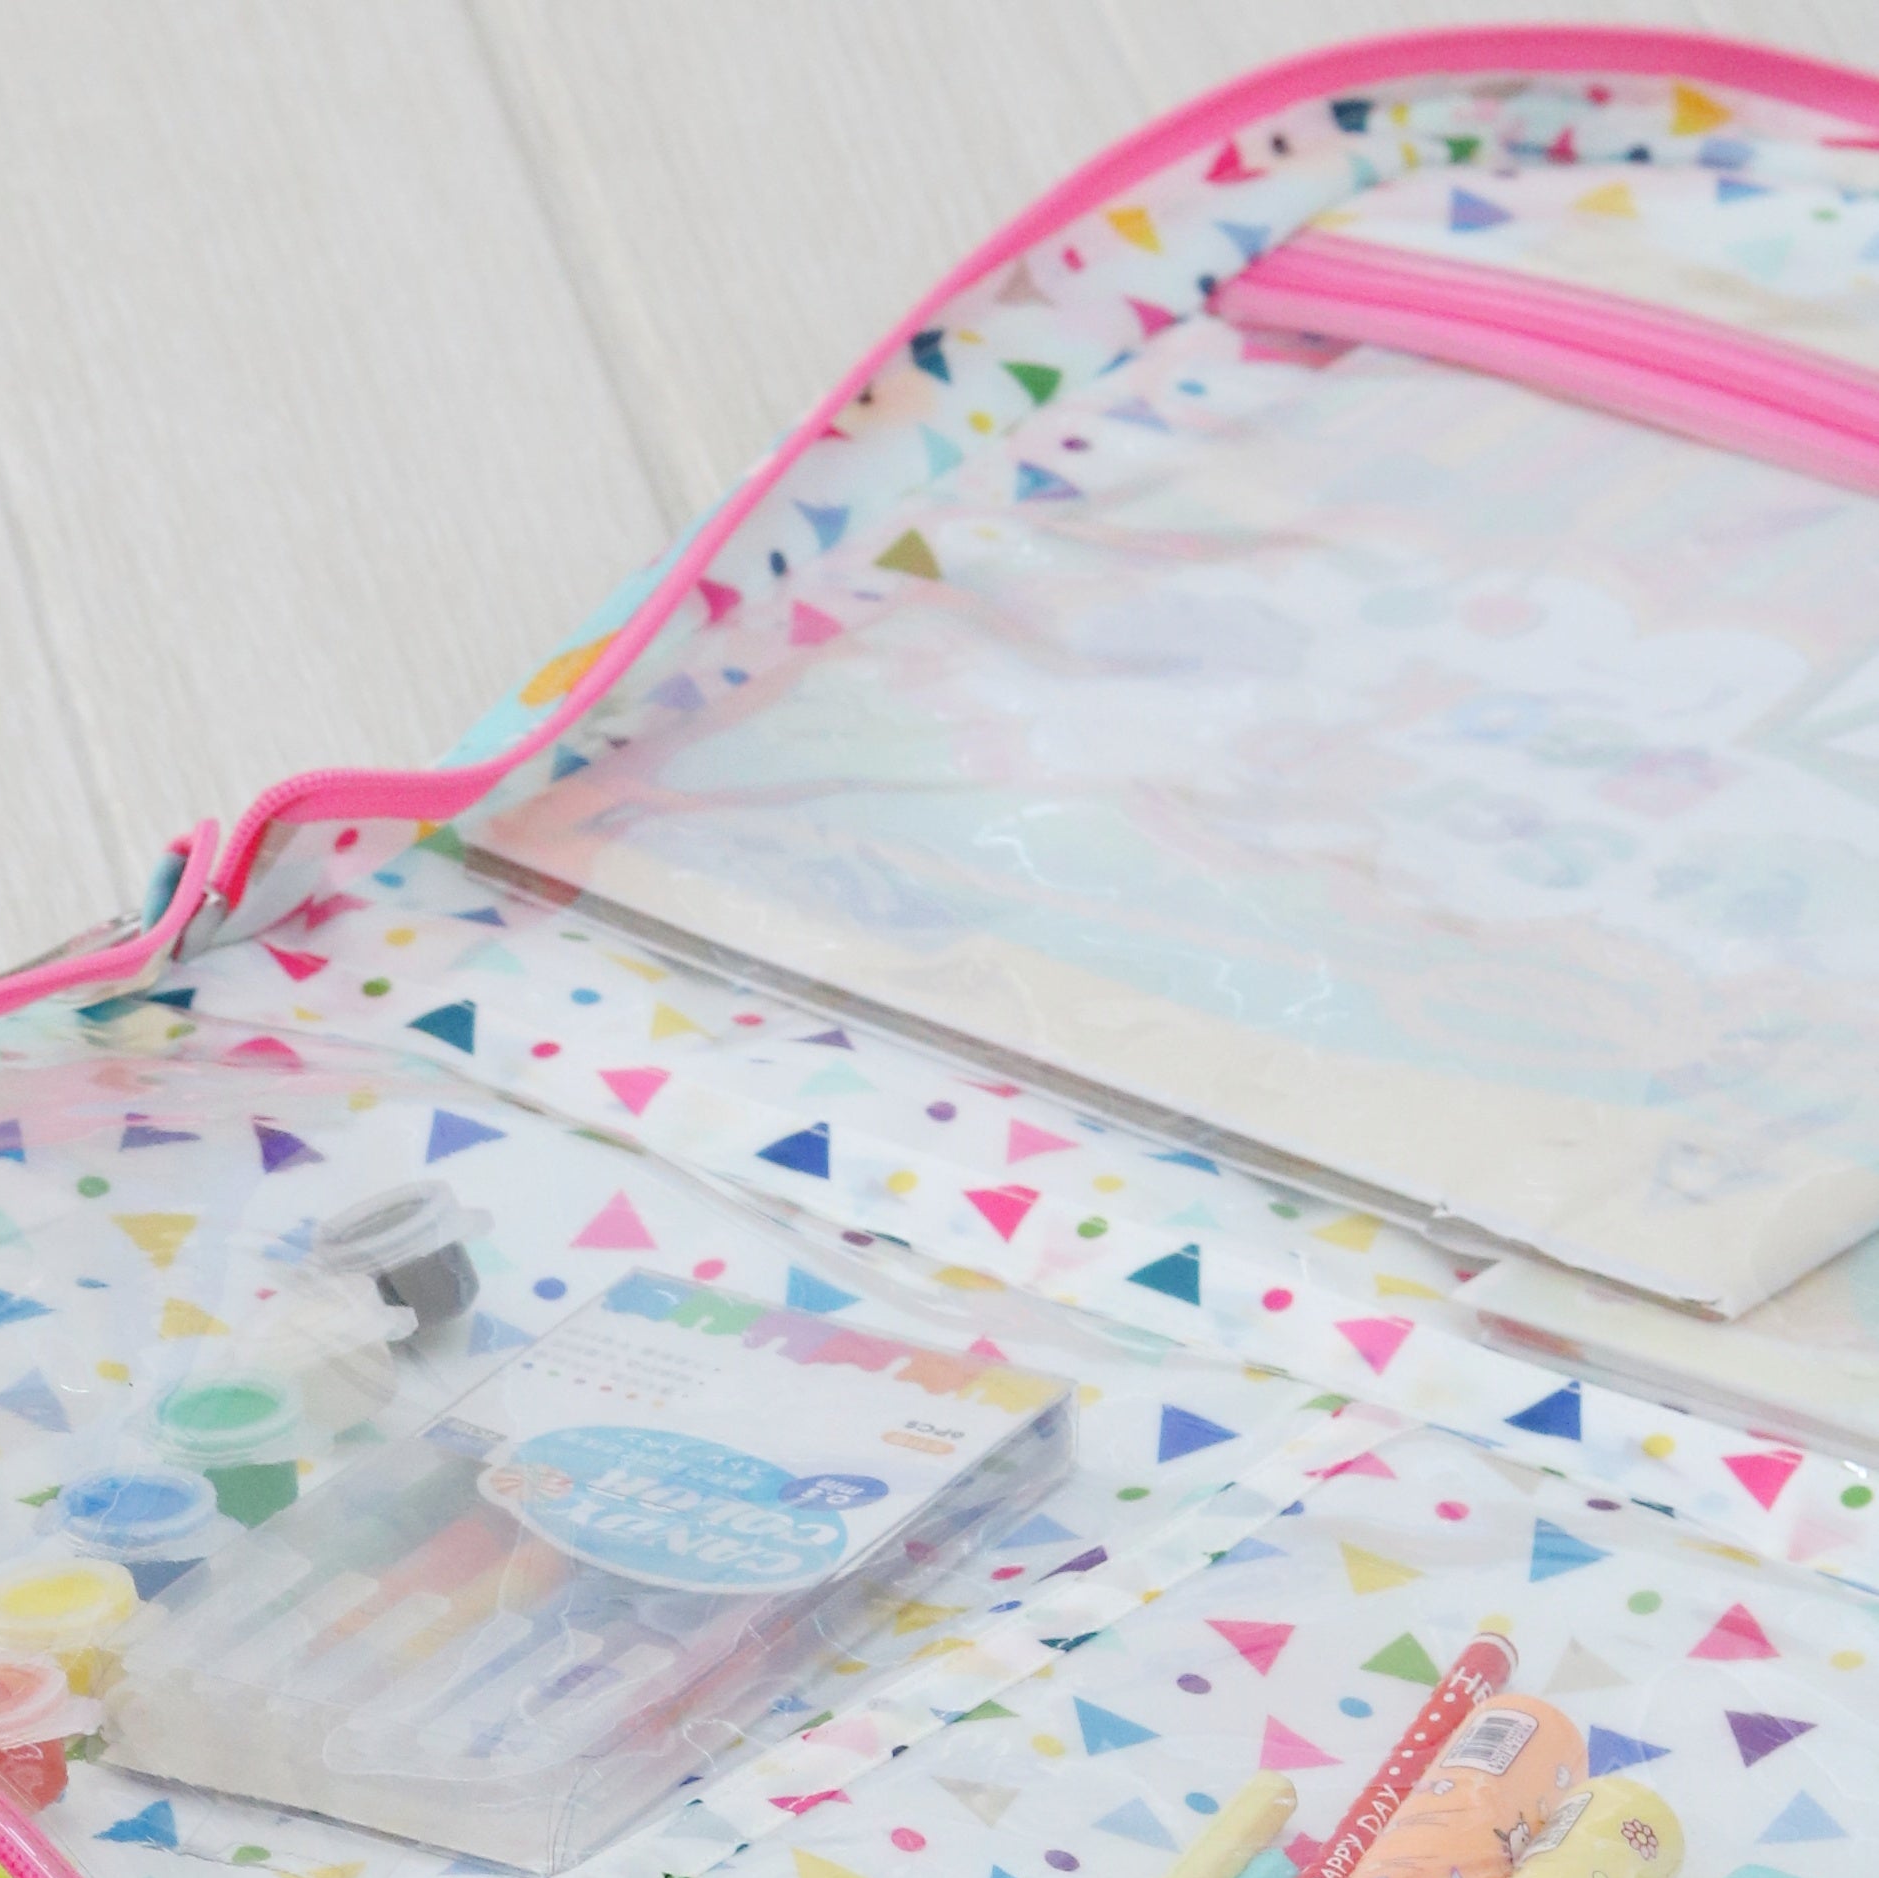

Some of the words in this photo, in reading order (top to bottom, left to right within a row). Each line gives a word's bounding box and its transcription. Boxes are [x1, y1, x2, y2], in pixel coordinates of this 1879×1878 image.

[571, 1500, 803, 1575] CANDY
[586, 1467, 840, 1547] COLOR
[1356, 1783, 1403, 1836] DAY
